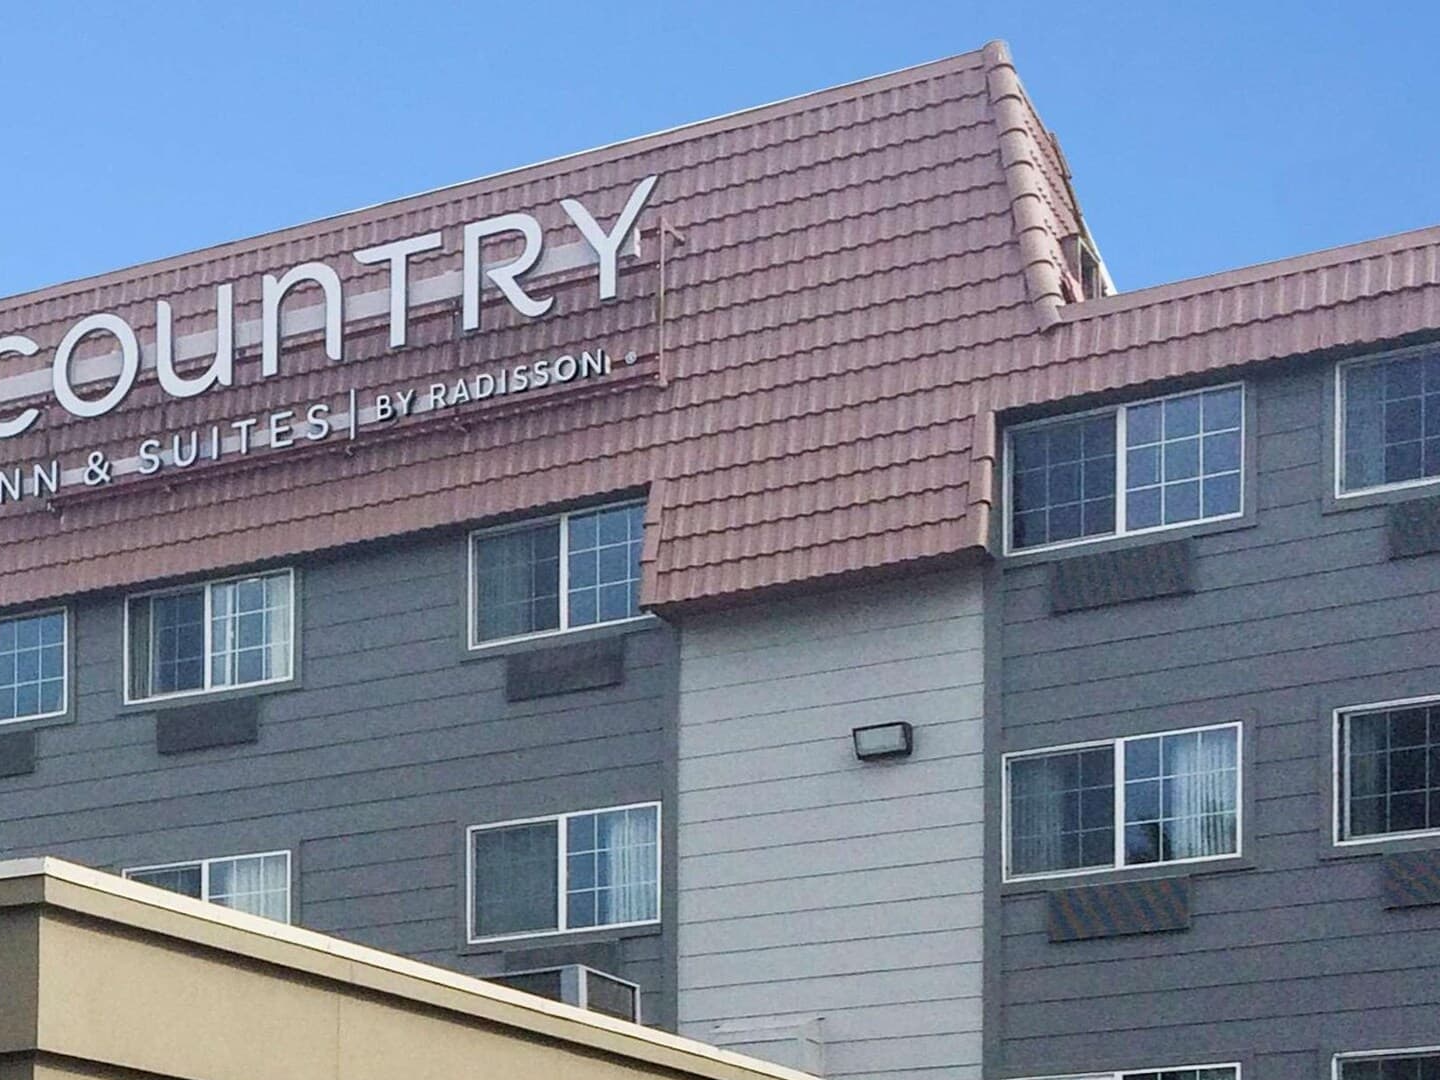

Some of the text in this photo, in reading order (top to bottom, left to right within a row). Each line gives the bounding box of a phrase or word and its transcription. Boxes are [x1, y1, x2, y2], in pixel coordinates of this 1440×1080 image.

[375, 348, 604, 422] BY RADISSON
[82, 450, 112, 487] &
[137, 403, 331, 475] SUITES
